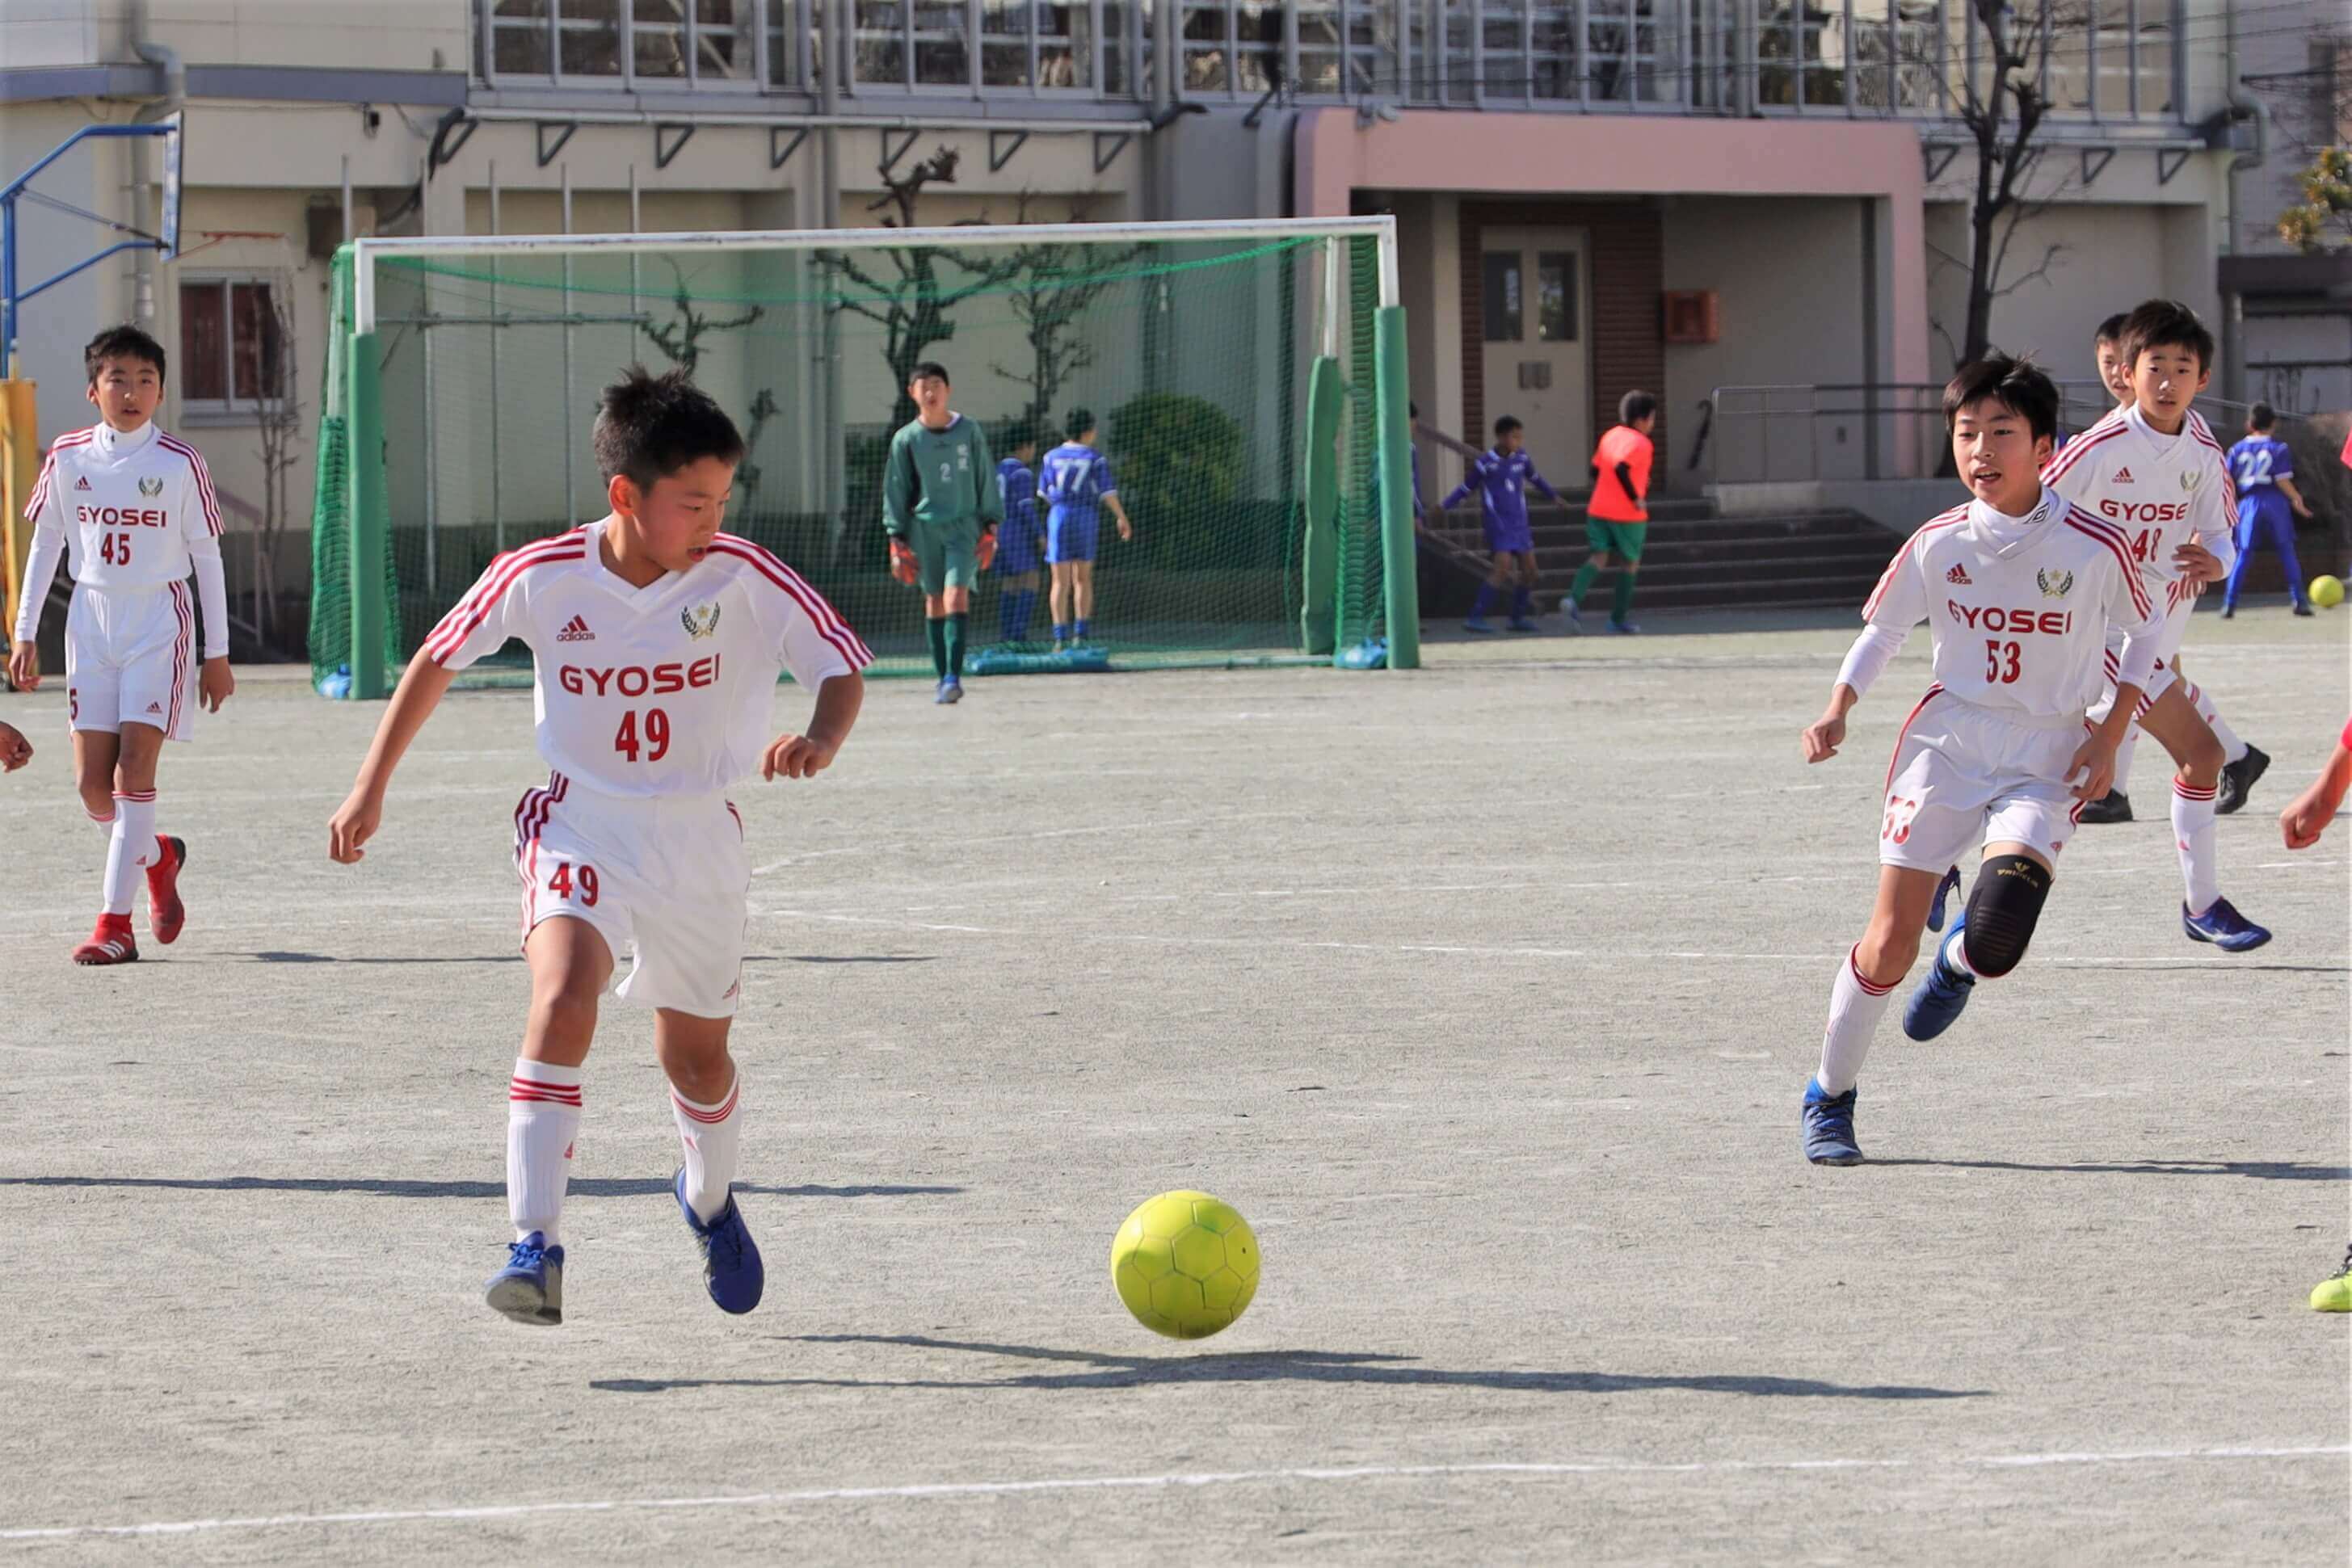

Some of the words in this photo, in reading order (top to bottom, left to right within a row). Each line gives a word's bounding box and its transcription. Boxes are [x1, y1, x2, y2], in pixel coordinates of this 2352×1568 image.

[940, 462, 951, 483] 2
[1052, 458, 1091, 493] 77
[2236, 449, 2273, 486] 22
[77, 506, 167, 528] GYOSEI
[2099, 498, 2189, 522] GYOSE
[100, 532, 131, 566] 45
[1948, 599, 2072, 635] GYOSEI
[556, 631, 596, 642] adidas
[559, 653, 721, 697] GYOSEI
[1985, 639, 2022, 684] 53
[615, 708, 671, 763] 49
[548, 862, 600, 907] 49
